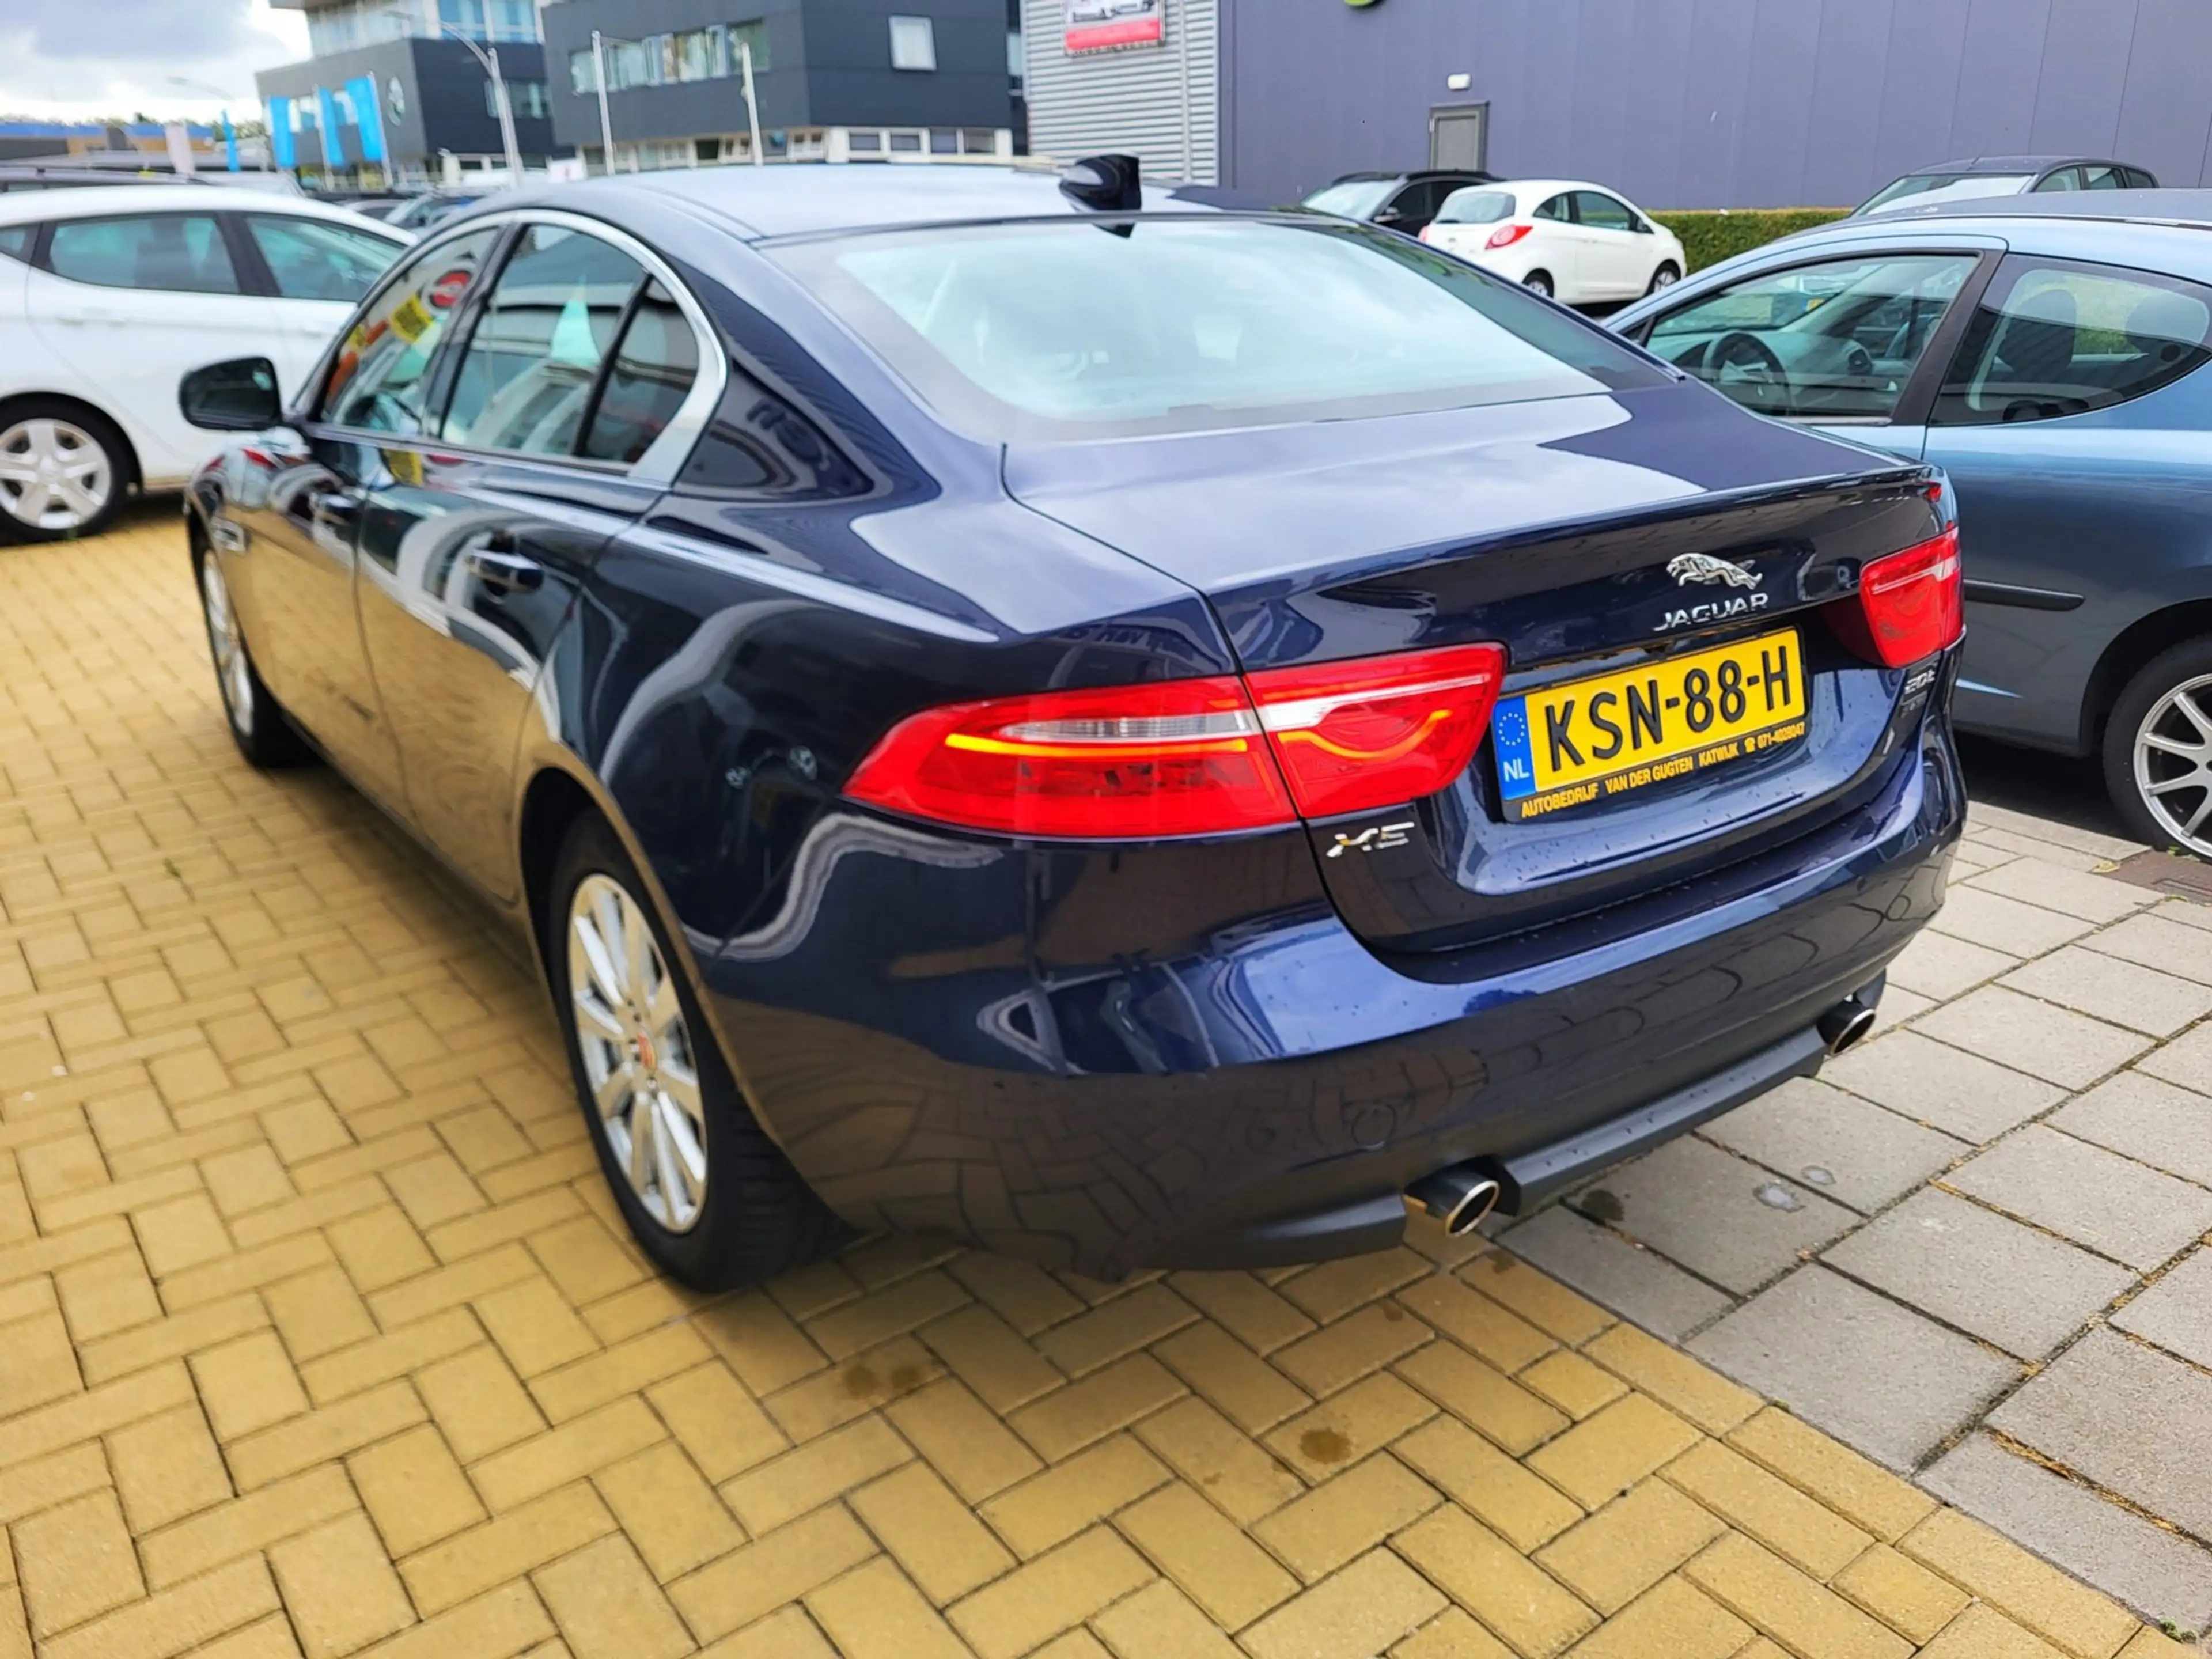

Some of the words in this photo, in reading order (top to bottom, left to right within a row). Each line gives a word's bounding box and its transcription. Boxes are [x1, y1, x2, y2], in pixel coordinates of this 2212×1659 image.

[1653, 593, 1769, 631] JAGUAR
[1545, 645, 1791, 772] KSN-88-H
[1503, 757, 1530, 782] NL
[1521, 782, 1599, 818] AUTOBEDRIJF
[1604, 774, 1628, 794] VAN
[1628, 768, 1652, 788] DER
[1652, 755, 1694, 781] GUGTEN
[1698, 741, 1740, 767] KATWIJK
[1326, 821, 1415, 858] XE
